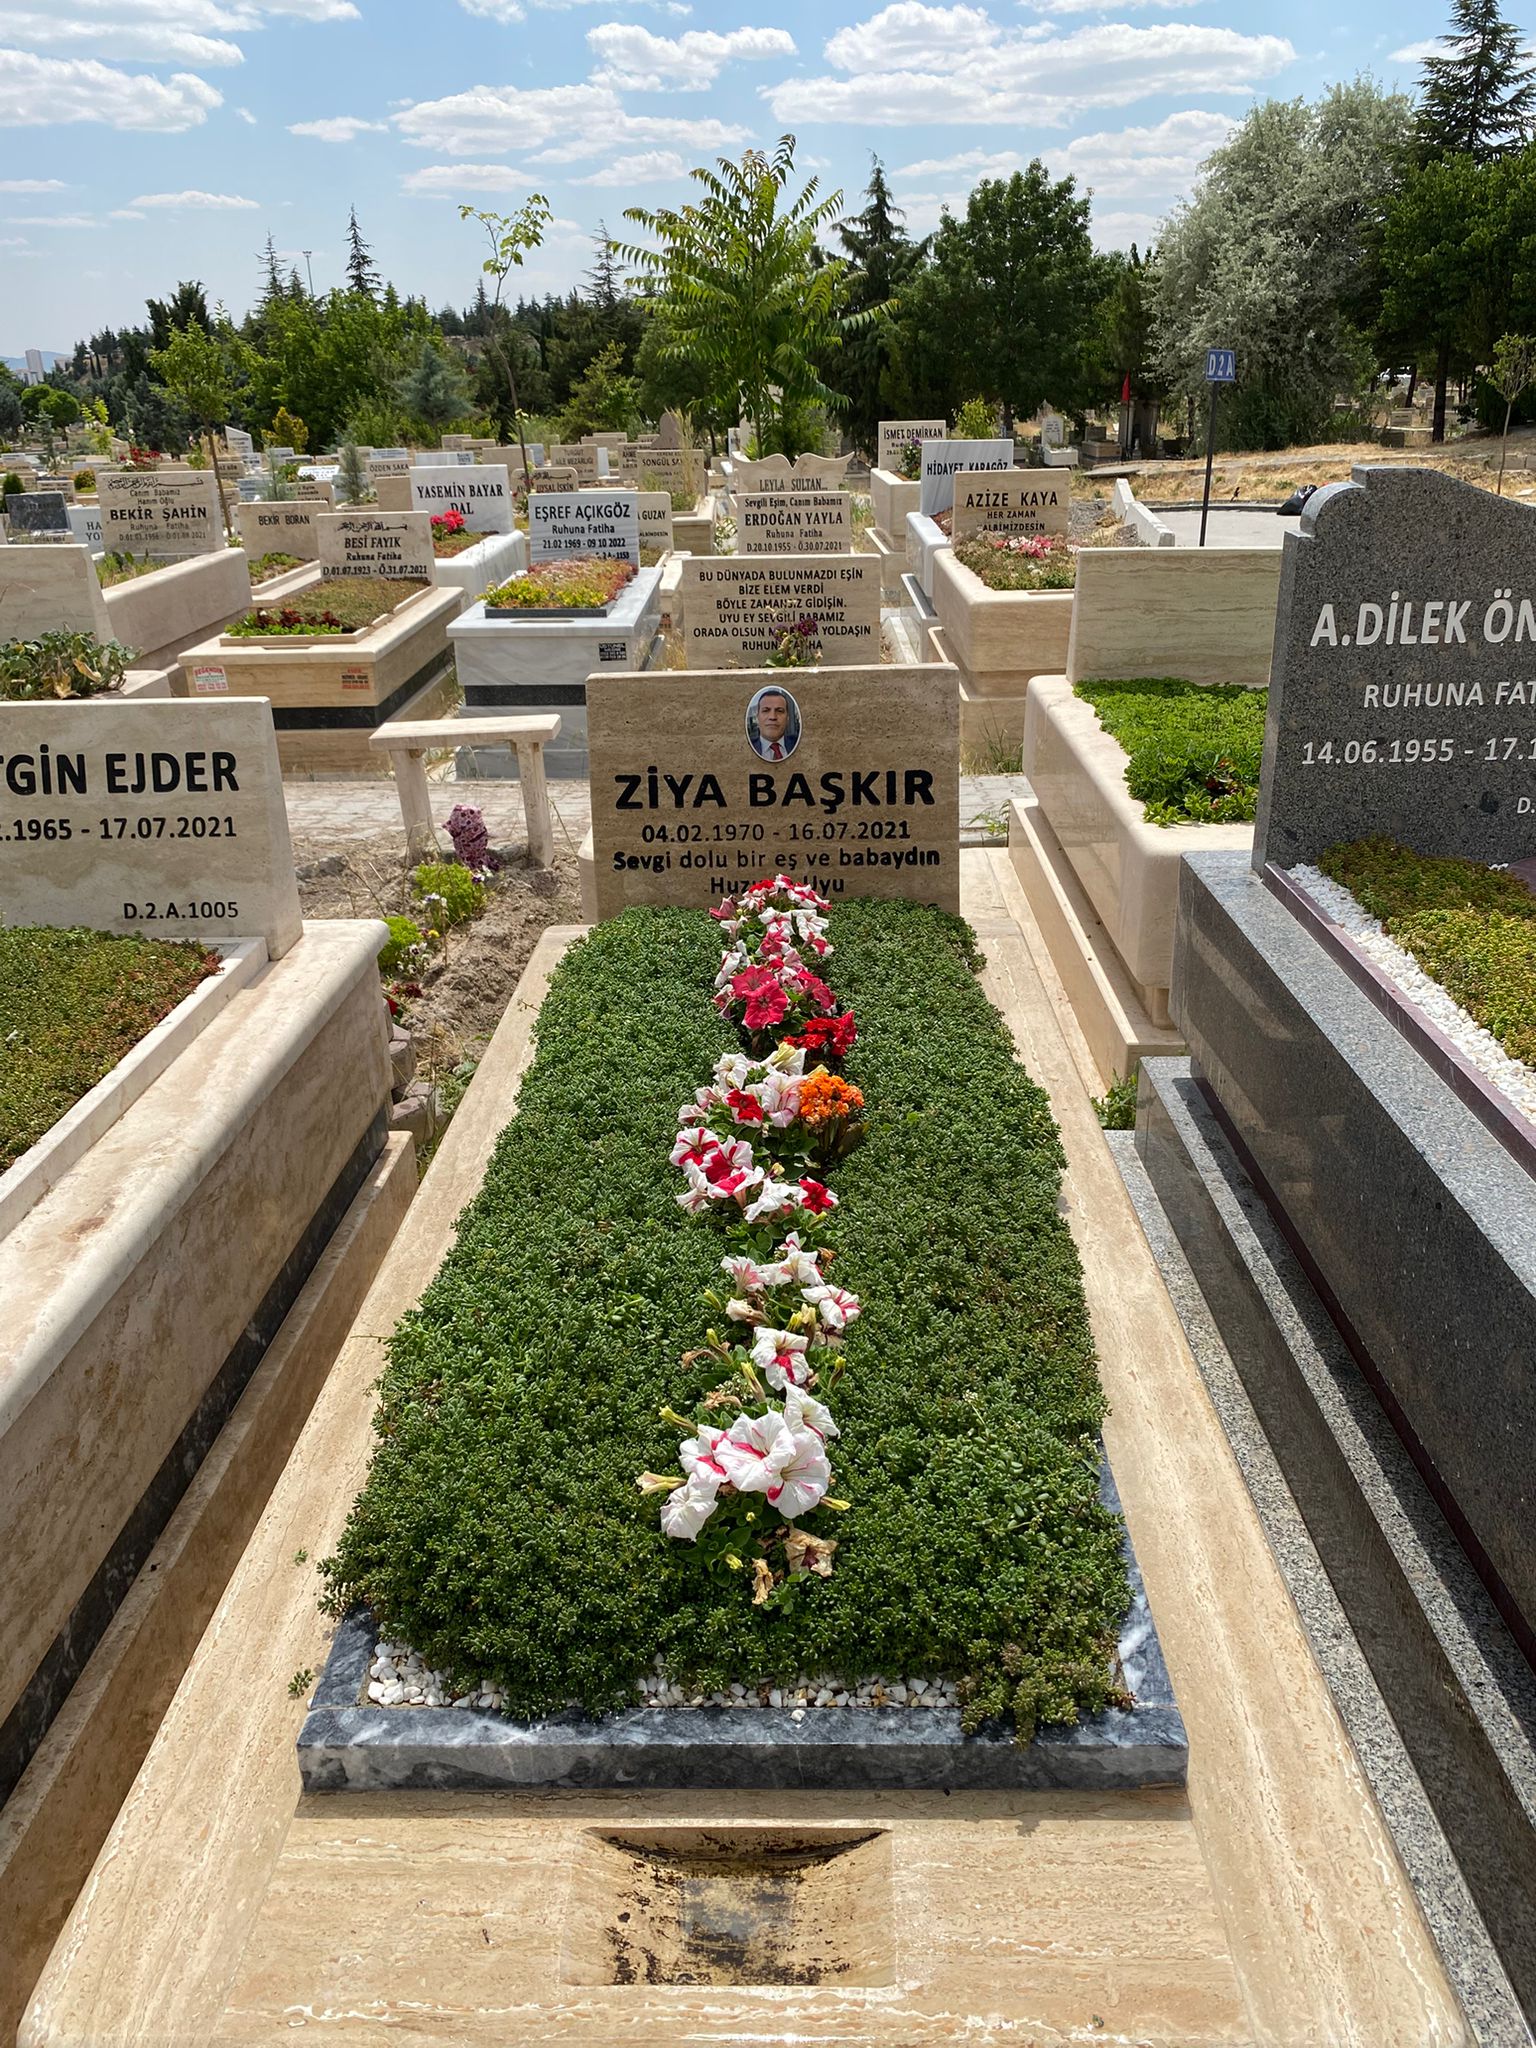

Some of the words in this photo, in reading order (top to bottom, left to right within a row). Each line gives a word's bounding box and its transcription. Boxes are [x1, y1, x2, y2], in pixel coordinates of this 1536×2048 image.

[1208, 354, 1233, 376] D2A
[906, 425, 943, 439] DEMİRKAN
[417, 482, 465, 498] YASEMİN
[470, 484, 504, 497] BAYAR
[760, 479, 785, 492] LEYLA
[966, 488, 1009, 508] AZİZE
[1021, 491, 1058, 506] KAYA
[110, 506, 153, 521] BEKİR
[162, 504, 206, 521] ŞAHİN
[450, 502, 474, 515] DAL
[535, 506, 571, 522] EŞREF
[575, 502, 630, 521] AÇIKGÖZ
[987, 511, 1004, 520] HER
[1006, 510, 1036, 519] ZAMAN
[745, 510, 801, 526] ERDOĞAN
[806, 512, 843, 525] YAYLA
[978, 520, 1045, 531] ALBİMİZDESİN
[552, 524, 585, 535] Ruhuna
[588, 524, 615, 534] Fatiha
[766, 529, 794, 539] Ruhuna
[800, 528, 823, 538] Fatiha
[344, 535, 368, 549] BESİ
[371, 537, 402, 549] FAYIK
[346, 552, 375, 561] Ruhuna
[377, 552, 402, 561] Fatiha
[699, 572, 713, 582] BU
[717, 569, 766, 582] DÜNYADA
[769, 570, 837, 581] BULUNMAZDI
[840, 567, 863, 582] EŞİN
[738, 584, 760, 595] BİZE
[764, 585, 790, 595] ELEM
[793, 582, 824, 595] VERDİ
[716, 598, 747, 610] BÖYLE
[719, 613, 740, 623] UYU
[743, 613, 755, 623] EY
[1310, 591, 1471, 647] A.DİLEK
[693, 628, 729, 638] ORADA
[731, 627, 765, 637] OLSUN
[822, 625, 871, 638] YOLDAŞIN
[742, 641, 781, 651] RUHUN
[1363, 682, 1483, 708] RUHUNA
[1301, 738, 1454, 765] 14.06.1955
[0, 744, 87, 796] GİN
[105, 752, 240, 794] EJDER
[614, 765, 727, 810] ZİYA
[749, 769, 936, 814] BAŞKIR
[100, 816, 237, 840] 17.07.2021
[641, 823, 765, 844] 04.02.1970
[789, 820, 911, 841] 16.07.2021
[613, 851, 671, 874] Sevgi
[680, 849, 728, 869] dolu
[737, 849, 766, 869] bir
[775, 854, 798, 871] eş
[806, 852, 830, 867] ve
[839, 846, 941, 871] babaydın
[124, 901, 239, 919] D.2.A.1005
